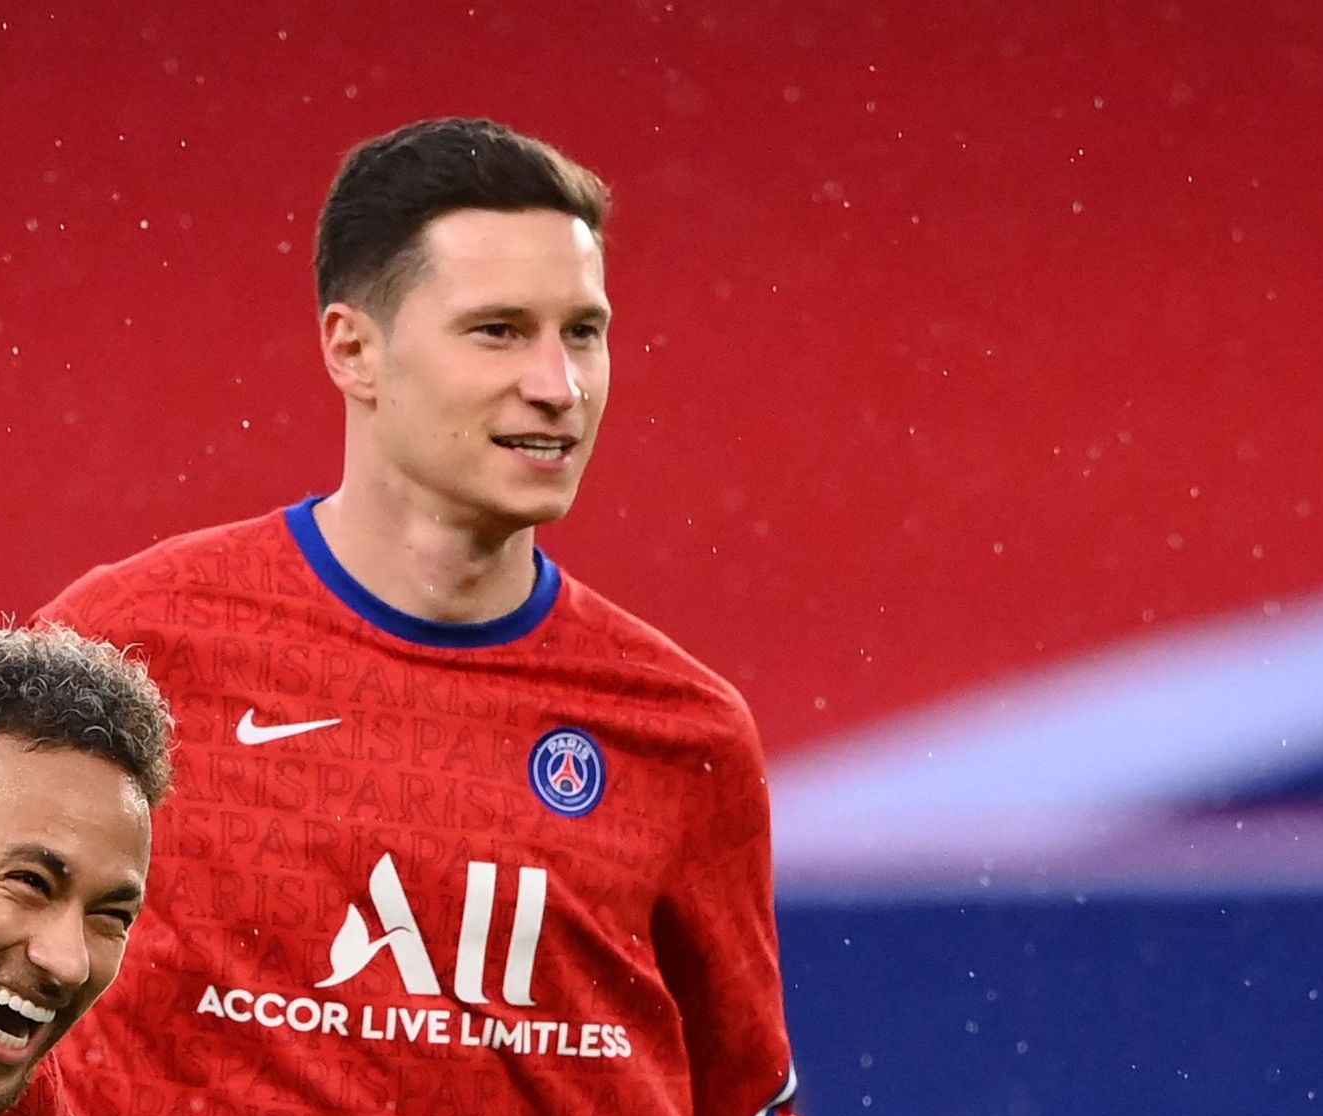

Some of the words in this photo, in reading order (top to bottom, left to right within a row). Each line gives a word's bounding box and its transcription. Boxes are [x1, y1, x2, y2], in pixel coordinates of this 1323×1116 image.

[197, 985, 349, 1037] ACCOR
[361, 1006, 450, 1044] LIVE
[460, 1011, 632, 1058] LIMITLESS
